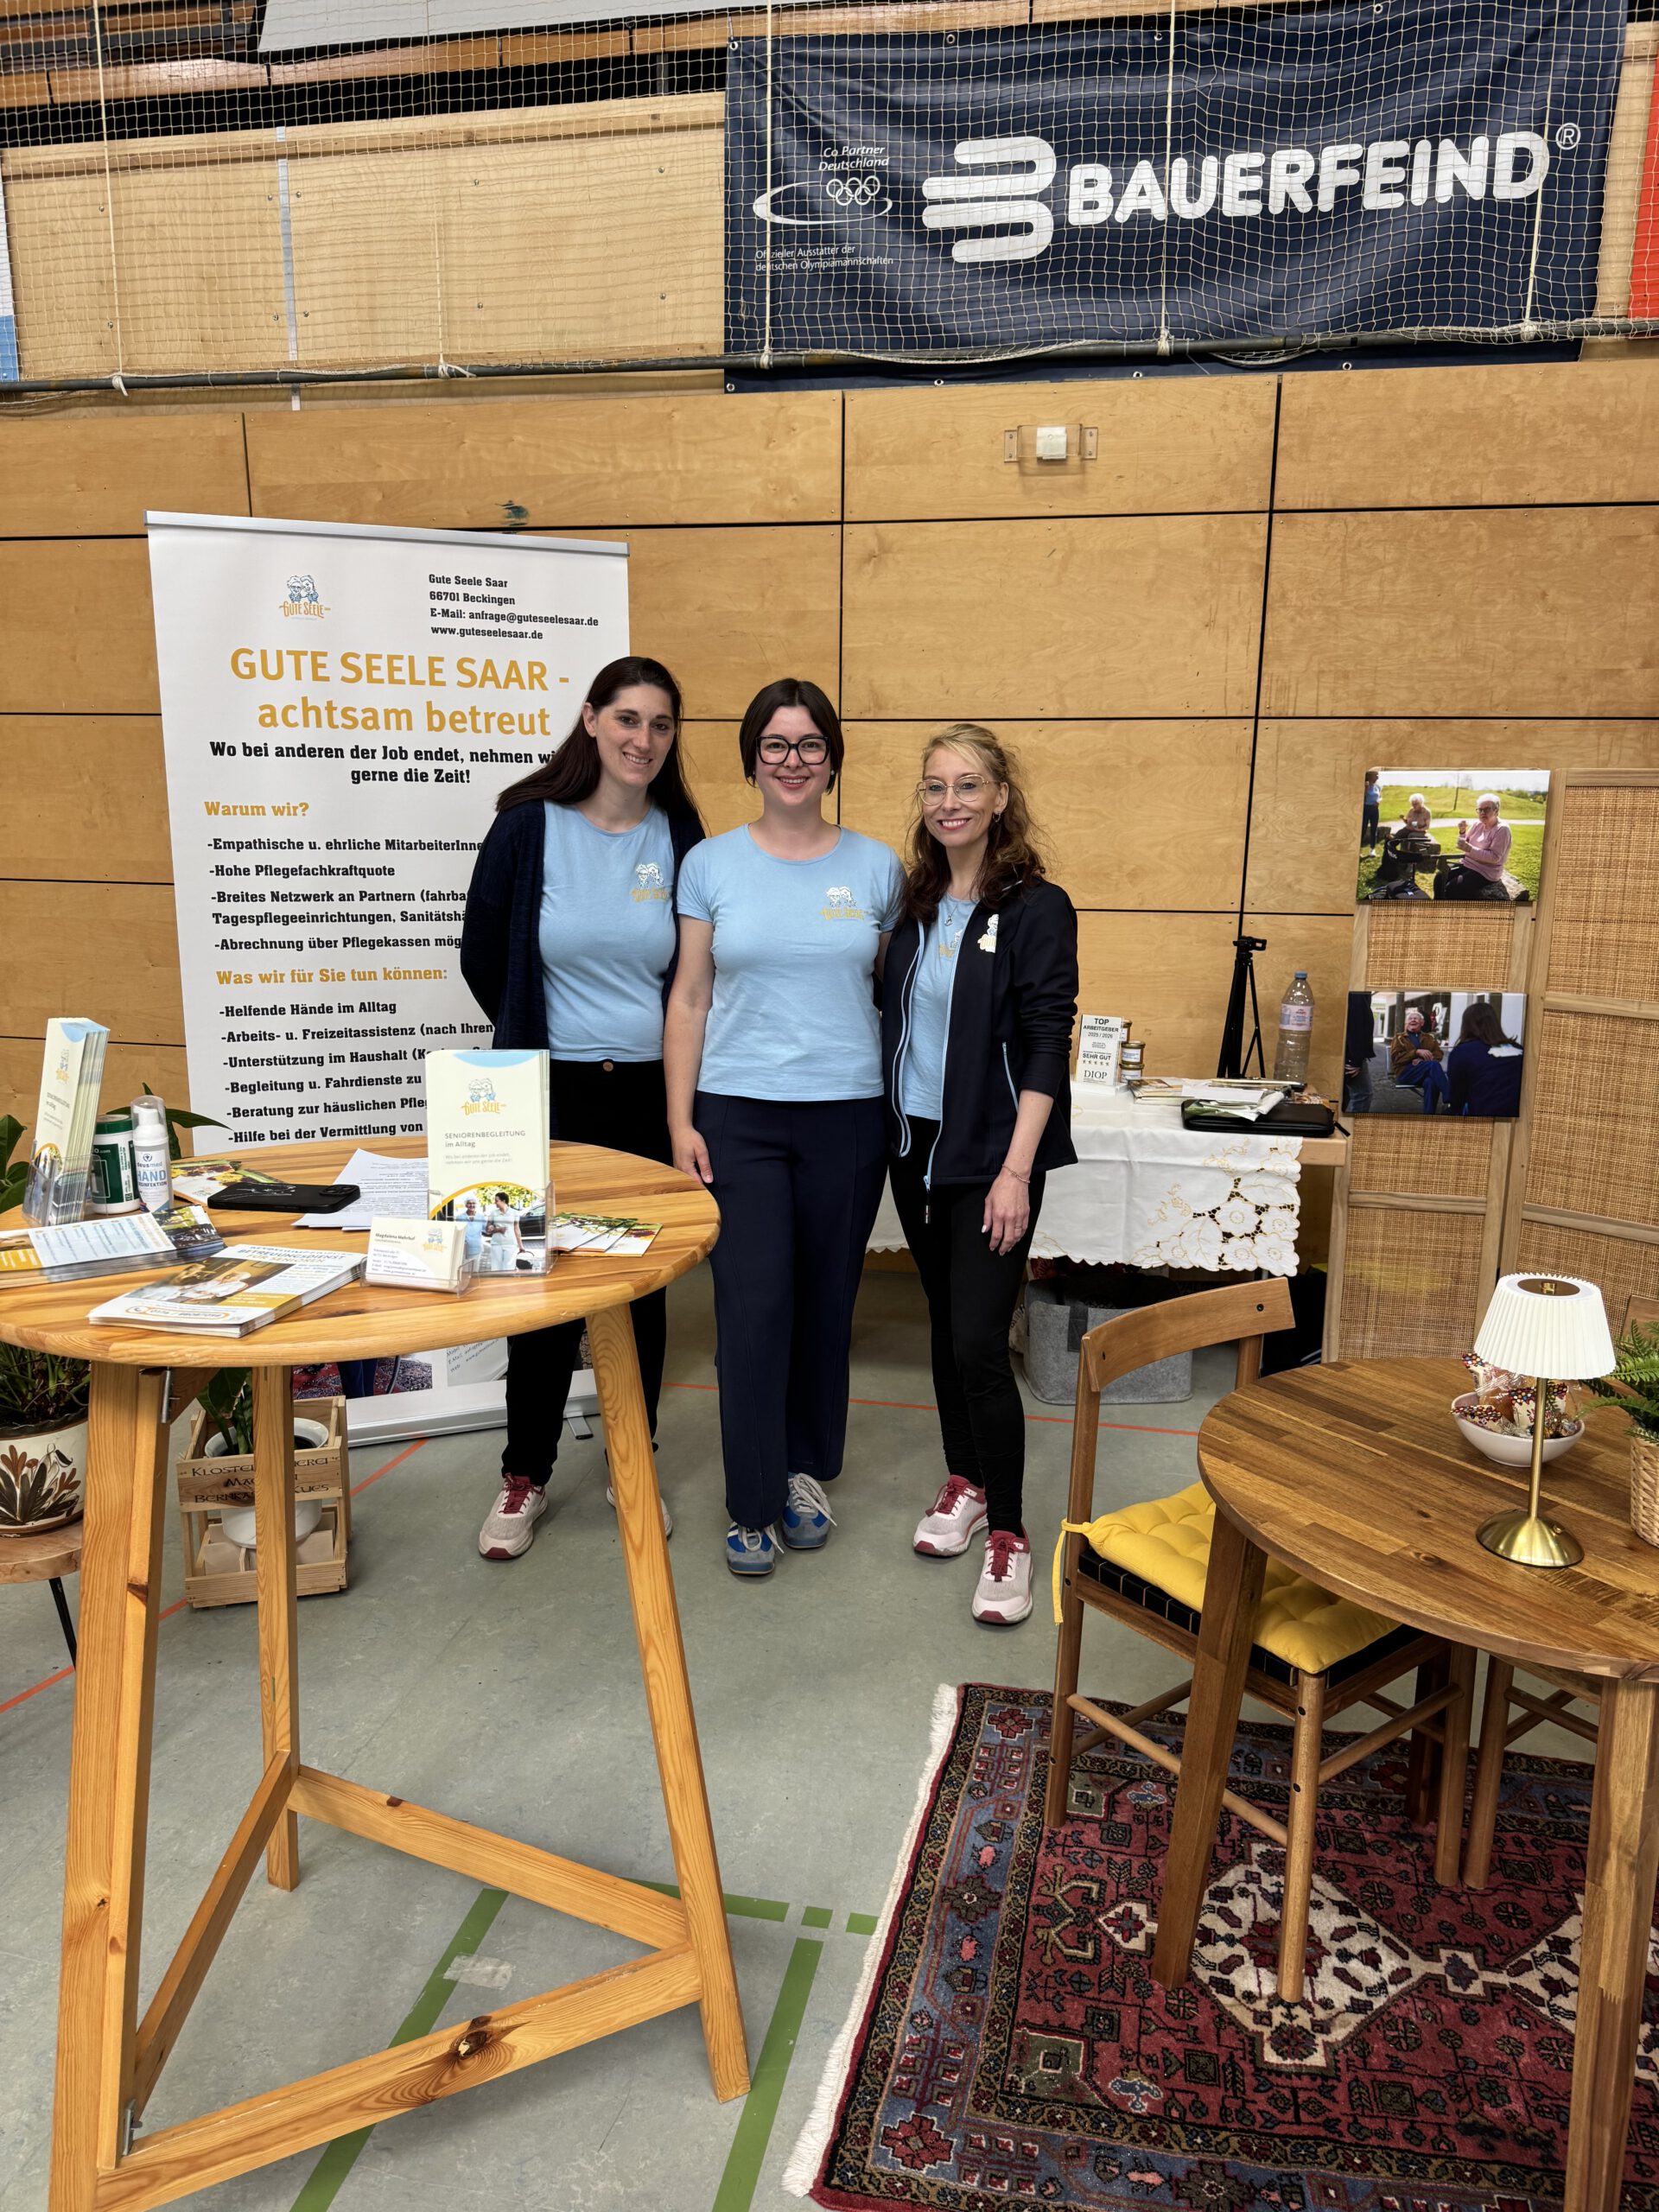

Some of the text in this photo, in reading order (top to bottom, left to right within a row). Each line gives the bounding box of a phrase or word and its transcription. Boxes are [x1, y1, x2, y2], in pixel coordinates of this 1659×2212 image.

[823, 145, 886, 157] Co Partner
[818, 157, 890, 172] Deutschland
[1068, 130, 1550, 226] BAUERFEIND
[755, 245, 855, 259] Ofzieller Ausstatter der
[755, 256, 893, 272] detschen Olympiamannschaften
[429, 575, 507, 588] Gute Seele Saar
[430, 591, 515, 606] 66701 Beckingen
[279, 601, 324, 619] GUTE SEELE
[430, 608, 598, 626] E-Mail: anfrage@guteseelesaar.de
[431, 627, 543, 639] www.guteseelesaar.de
[231, 648, 329, 682] GUTE
[340, 652, 446, 687] SEELE
[456, 658, 550, 691] SAAR
[258, 696, 550, 736] achtsam betreut
[210, 741, 236, 756] Wo
[242, 742, 269, 757] bei
[276, 744, 344, 758] anderen
[351, 745, 377, 759] der
[382, 746, 408, 760] Job
[414, 747, 464, 763] endet,
[470, 749, 532, 763] nehmen
[352, 768, 470, 784] gerne die Zeit!
[204, 802, 308, 816] Warum wir?
[208, 838, 303, 852] -Empathische
[326, 839, 380, 849] ehrliche
[385, 839, 481, 851] MitarbeiterInne
[210, 865, 395, 879] -Hohe Pflegefachkraftquote
[212, 892, 265, 902] -Breites
[270, 891, 334, 902] Netzwerk
[359, 891, 415, 901] Partnern
[421, 889, 465, 902] (fahrba
[213, 911, 463, 926] Tagespflegeeinrichtungen, Sanitätshä
[215, 936, 461, 951] -Abrechnung über Pflegekassen mög
[216, 968, 448, 985] Was wir für Sie tun können:
[219, 1001, 396, 1016] -Helfende Hände im Alltag
[221, 1031, 280, 1042] -Arbeits-
[302, 1027, 416, 1039] Freizeitassistenz
[420, 1024, 456, 1036] (nach
[461, 1021, 493, 1033] Ihren
[224, 1055, 324, 1067] -Unterstützung
[329, 1053, 345, 1063] im
[350, 1050, 407, 1062] Haushalt
[1084, 1070, 1107, 1079] DIOP
[226, 1081, 303, 1094] -Begleitung
[325, 1075, 402, 1088] Fahrdienste
[227, 1107, 293, 1117] -Beratung
[324, 1100, 396, 1113] häuslichen
[400, 1097, 427, 1109] Pfle
[229, 1129, 265, 1142] -Hilfe
[270, 1129, 289, 1141] bei
[295, 1128, 315, 1139] der
[320, 1124, 396, 1137] Vermittlung
[445, 1130, 526, 1139] SENIORENBEGLEITUNG
[138, 1170, 166, 1182] HAND
